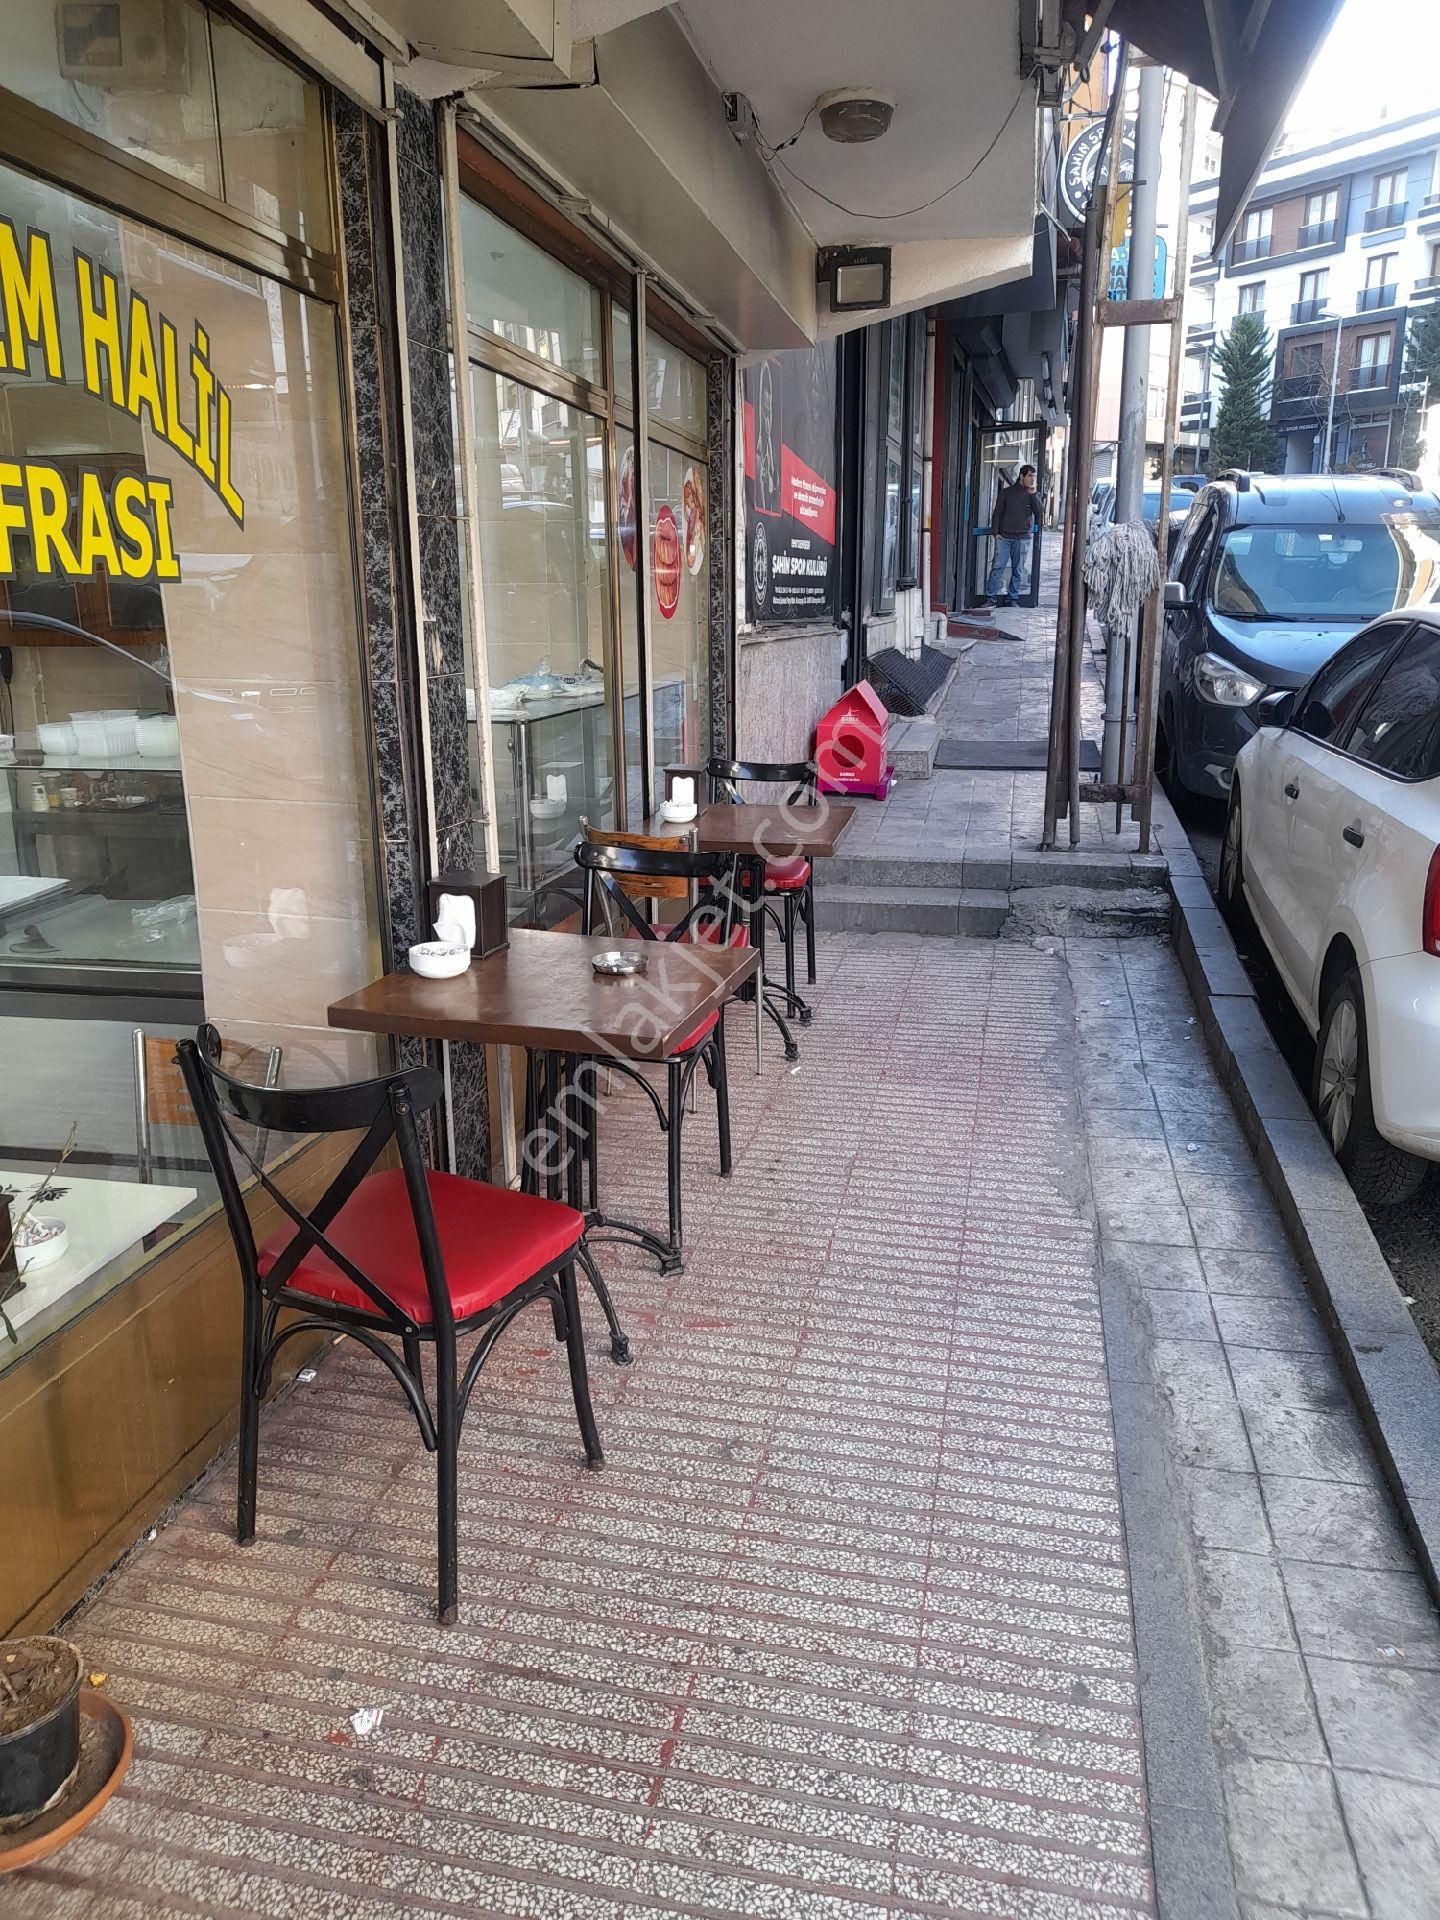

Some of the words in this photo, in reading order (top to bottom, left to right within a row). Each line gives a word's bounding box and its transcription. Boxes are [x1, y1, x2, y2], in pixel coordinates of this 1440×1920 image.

[74, 247, 244, 532] HALİL
[772, 550, 790, 579] ŞAHİN
[791, 557, 806, 576] SPOR
[806, 555, 828, 577] KULÜBÜ
